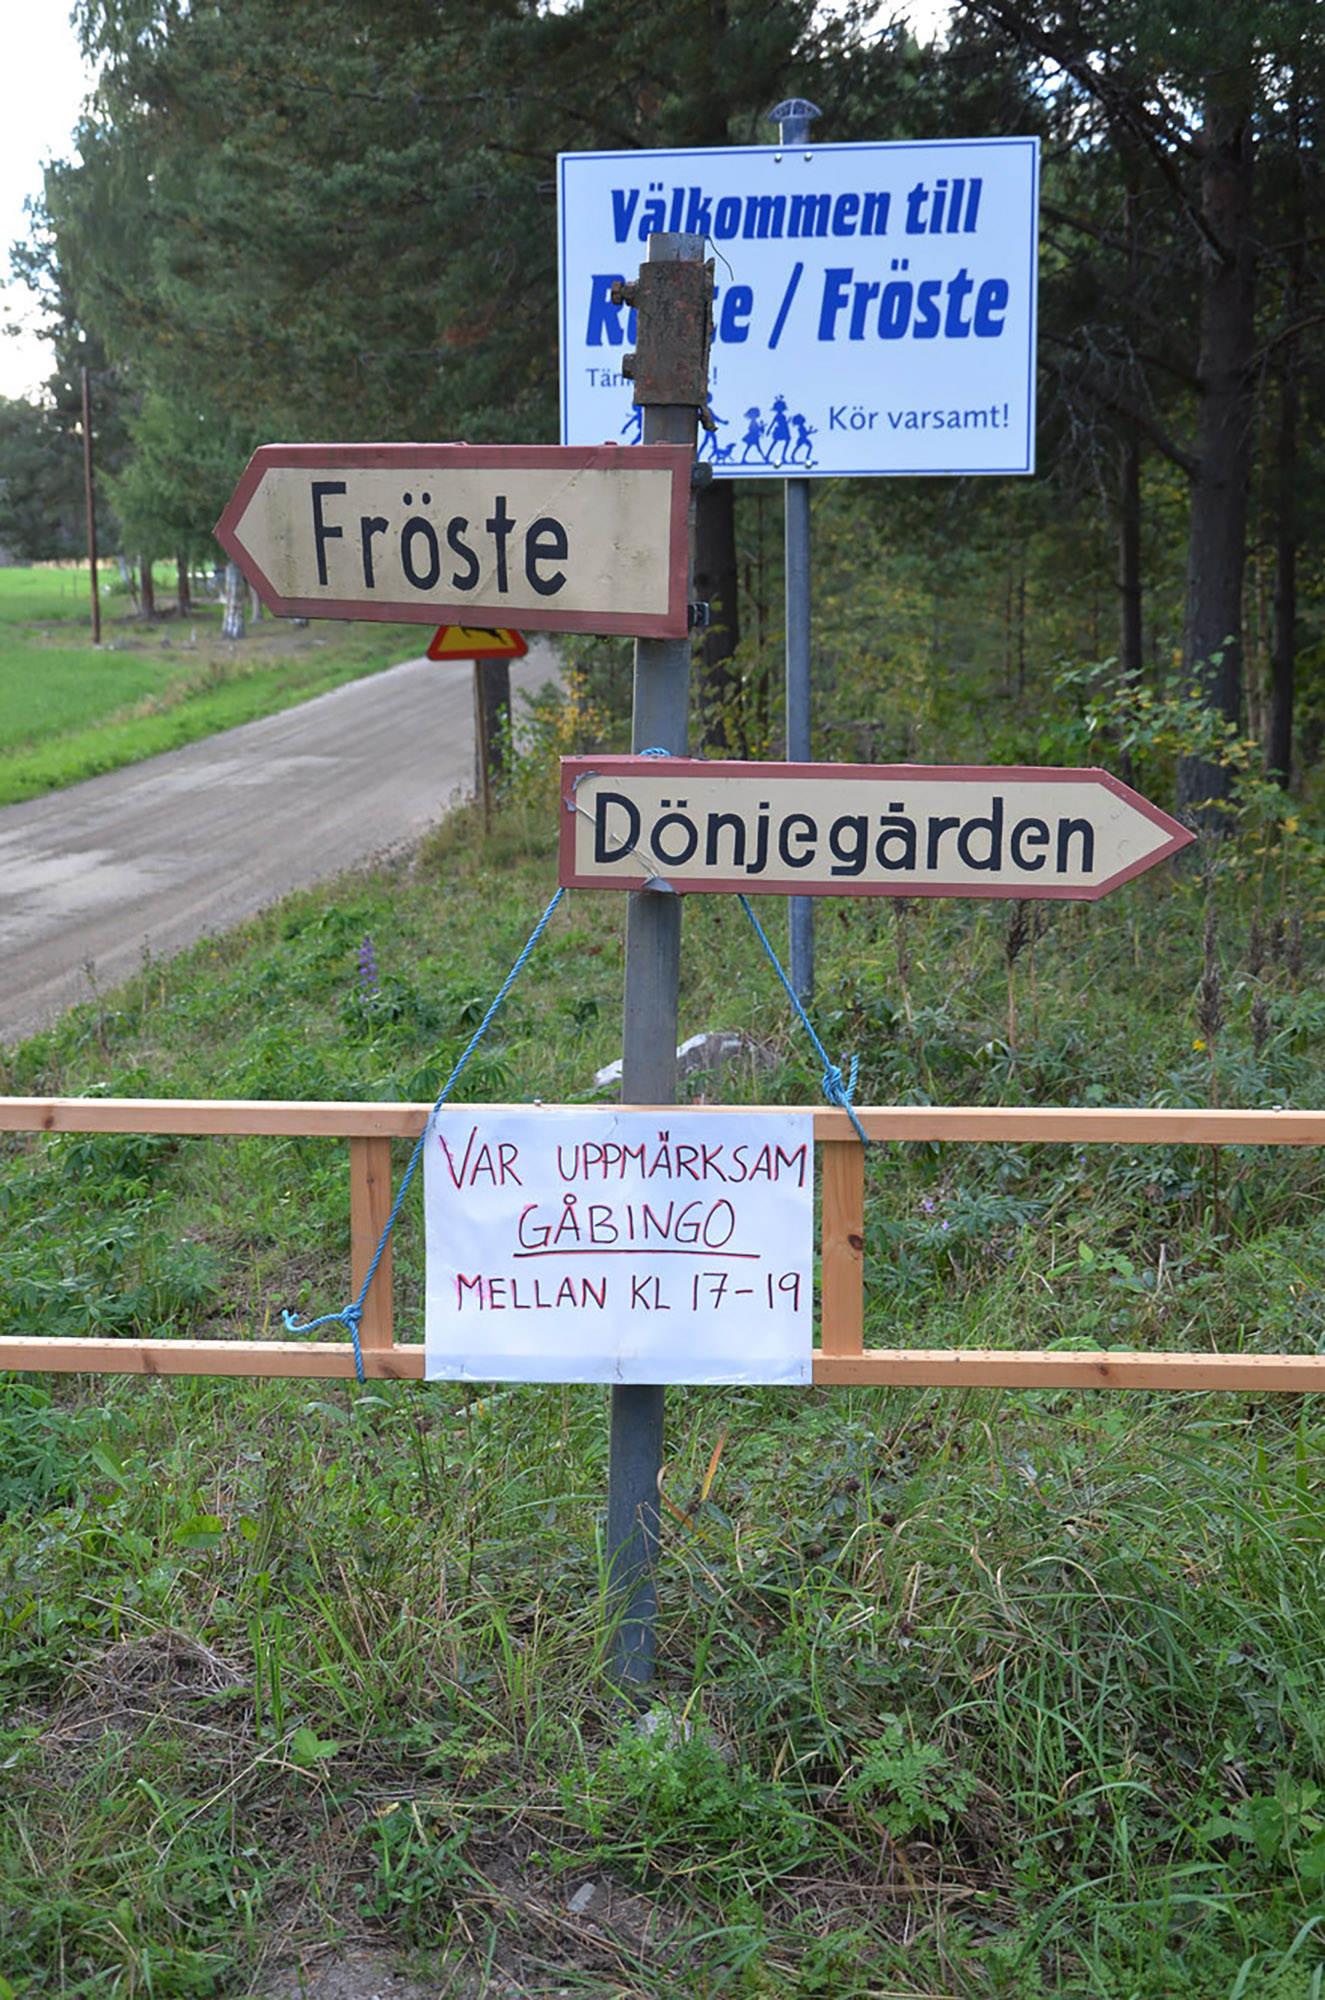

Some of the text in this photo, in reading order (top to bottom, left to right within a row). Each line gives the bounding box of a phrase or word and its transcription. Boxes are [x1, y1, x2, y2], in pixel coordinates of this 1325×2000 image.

[611, 177, 982, 243] Välkommen till
[817, 259, 1009, 341] Fröste
[828, 402, 1009, 431] Kör varsamt!
[311, 481, 569, 596] Fröste
[594, 792, 1095, 876] Dönjegården
[438, 1125, 808, 1190] VAR UPPMÄRKSAM
[517, 1193, 736, 1249] GÅBINGO
[456, 1273, 607, 1311] MELLAN
[630, 1274, 671, 1311] KL
